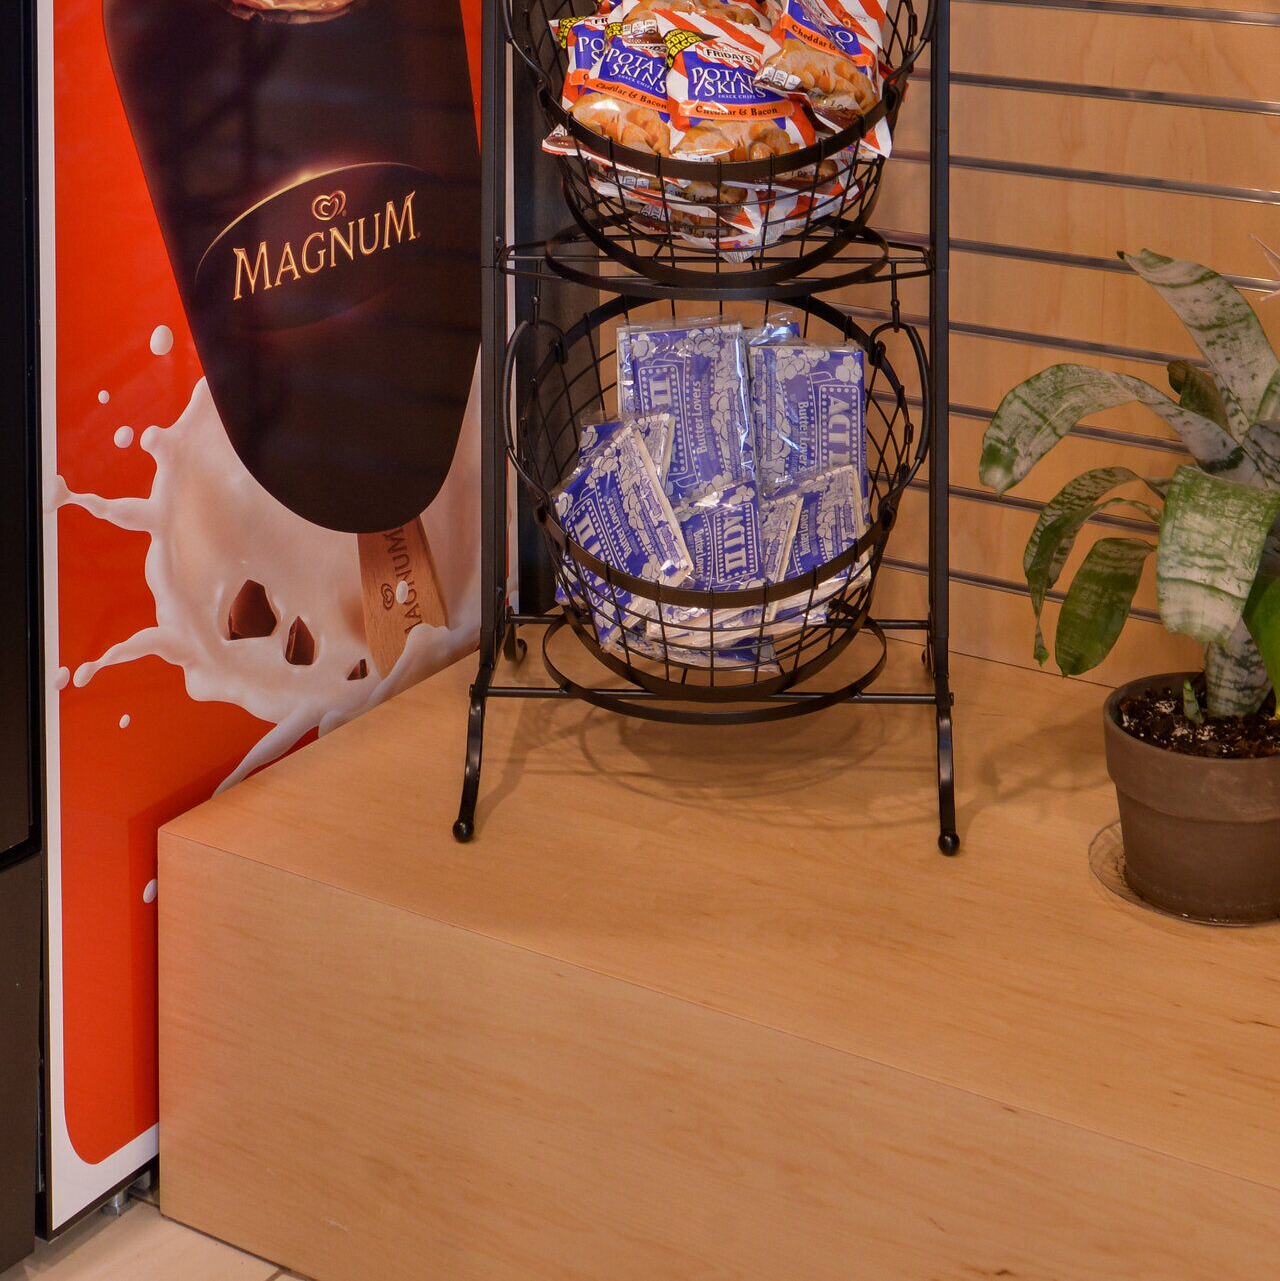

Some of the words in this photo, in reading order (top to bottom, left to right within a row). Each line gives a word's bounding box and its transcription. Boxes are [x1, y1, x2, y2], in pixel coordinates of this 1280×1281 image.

[790, 23, 827, 49] Cheddar
[609, 61, 667, 95] SKINS
[703, 80, 768, 100] SKINS
[595, 80, 628, 97] Cheddar
[628, 89, 639, 100] &
[639, 96, 669, 110] Bacon
[738, 106, 749, 116] &
[750, 106, 780, 116] Bacon
[232, 189, 417, 301] MAGNUM
[692, 379, 707, 419] Lovers
[797, 400, 809, 432] Butter
[696, 418, 711, 455] Butter
[616, 525, 634, 559] Butter
